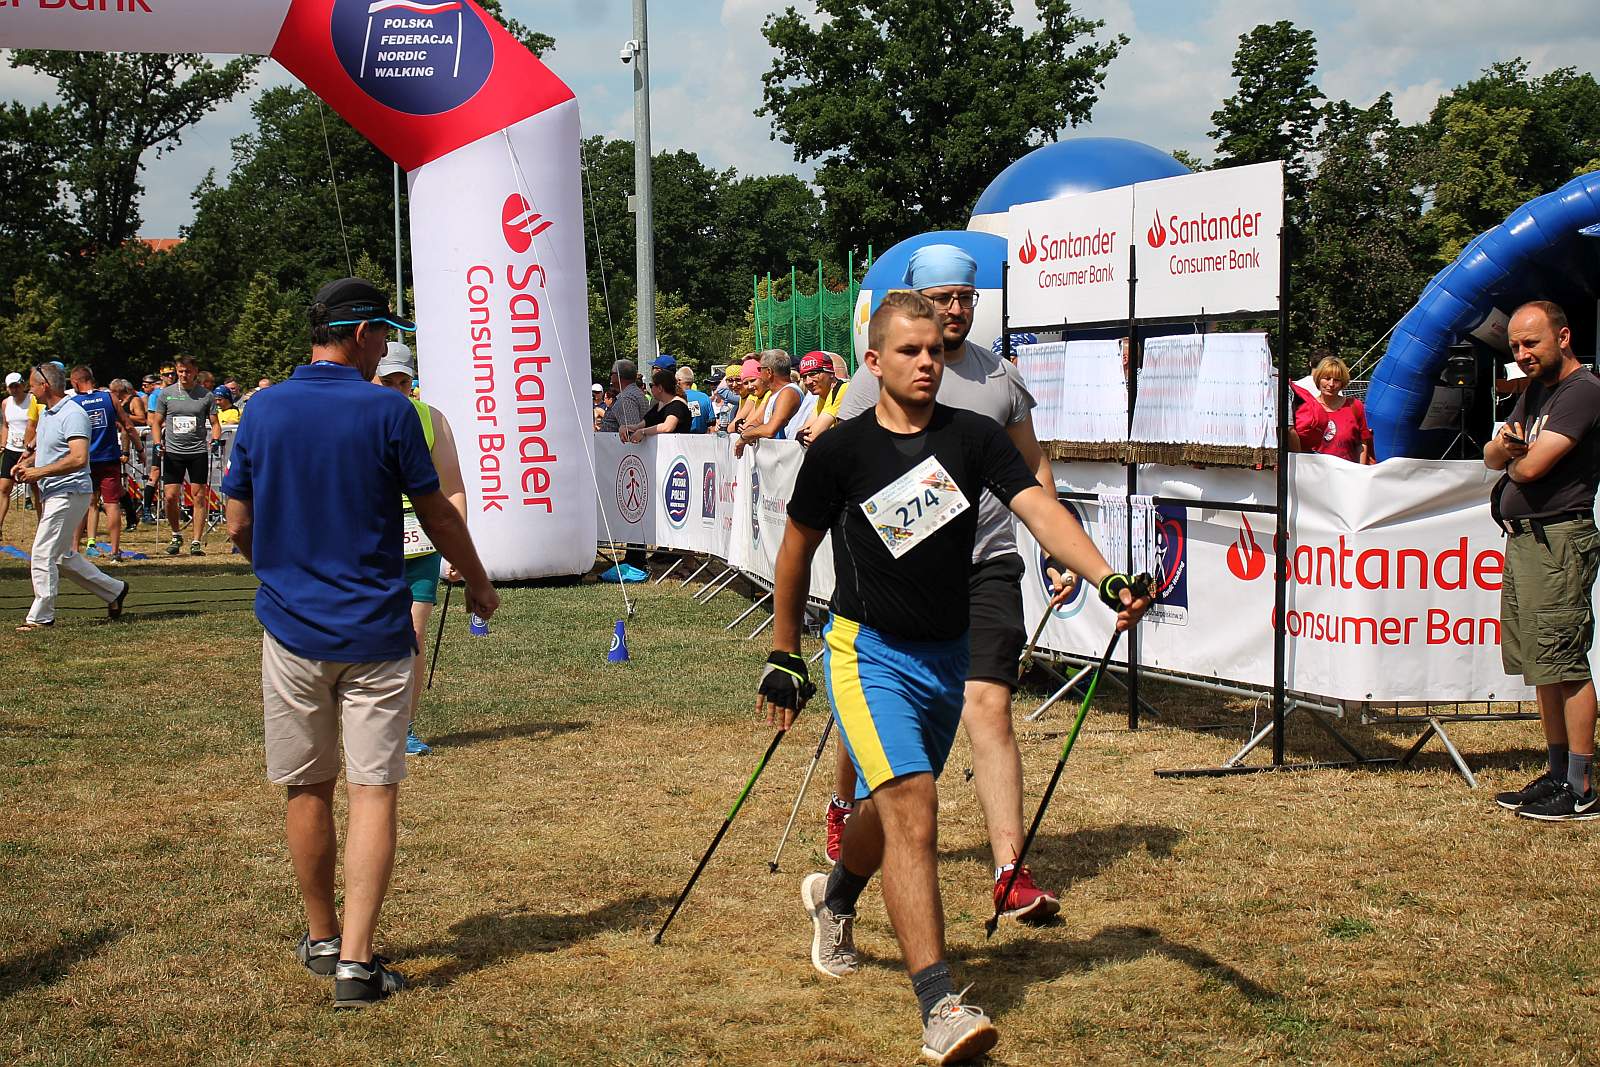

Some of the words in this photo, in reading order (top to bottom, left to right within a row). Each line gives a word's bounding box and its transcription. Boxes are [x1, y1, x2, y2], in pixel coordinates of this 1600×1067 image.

[380, 34, 454, 45] FEDERACJA
[383, 18, 433, 29] POLSKA
[375, 66, 434, 78] WALKING
[377, 50, 427, 62] NORDIC
[1169, 208, 1262, 245] Santander
[1040, 228, 1116, 262] Santander
[1169, 253, 1227, 275] Consumer
[1229, 247, 1260, 270] Bank
[1038, 268, 1087, 289] Consumer
[1089, 264, 1114, 284] Bank
[466, 265, 498, 427] Consumer
[506, 264, 557, 513] Santander
[478, 433, 509, 512] Bank
[895, 488, 940, 527] 274
[1272, 606, 1419, 646] onsumer
[1426, 608, 1501, 646] Ban
